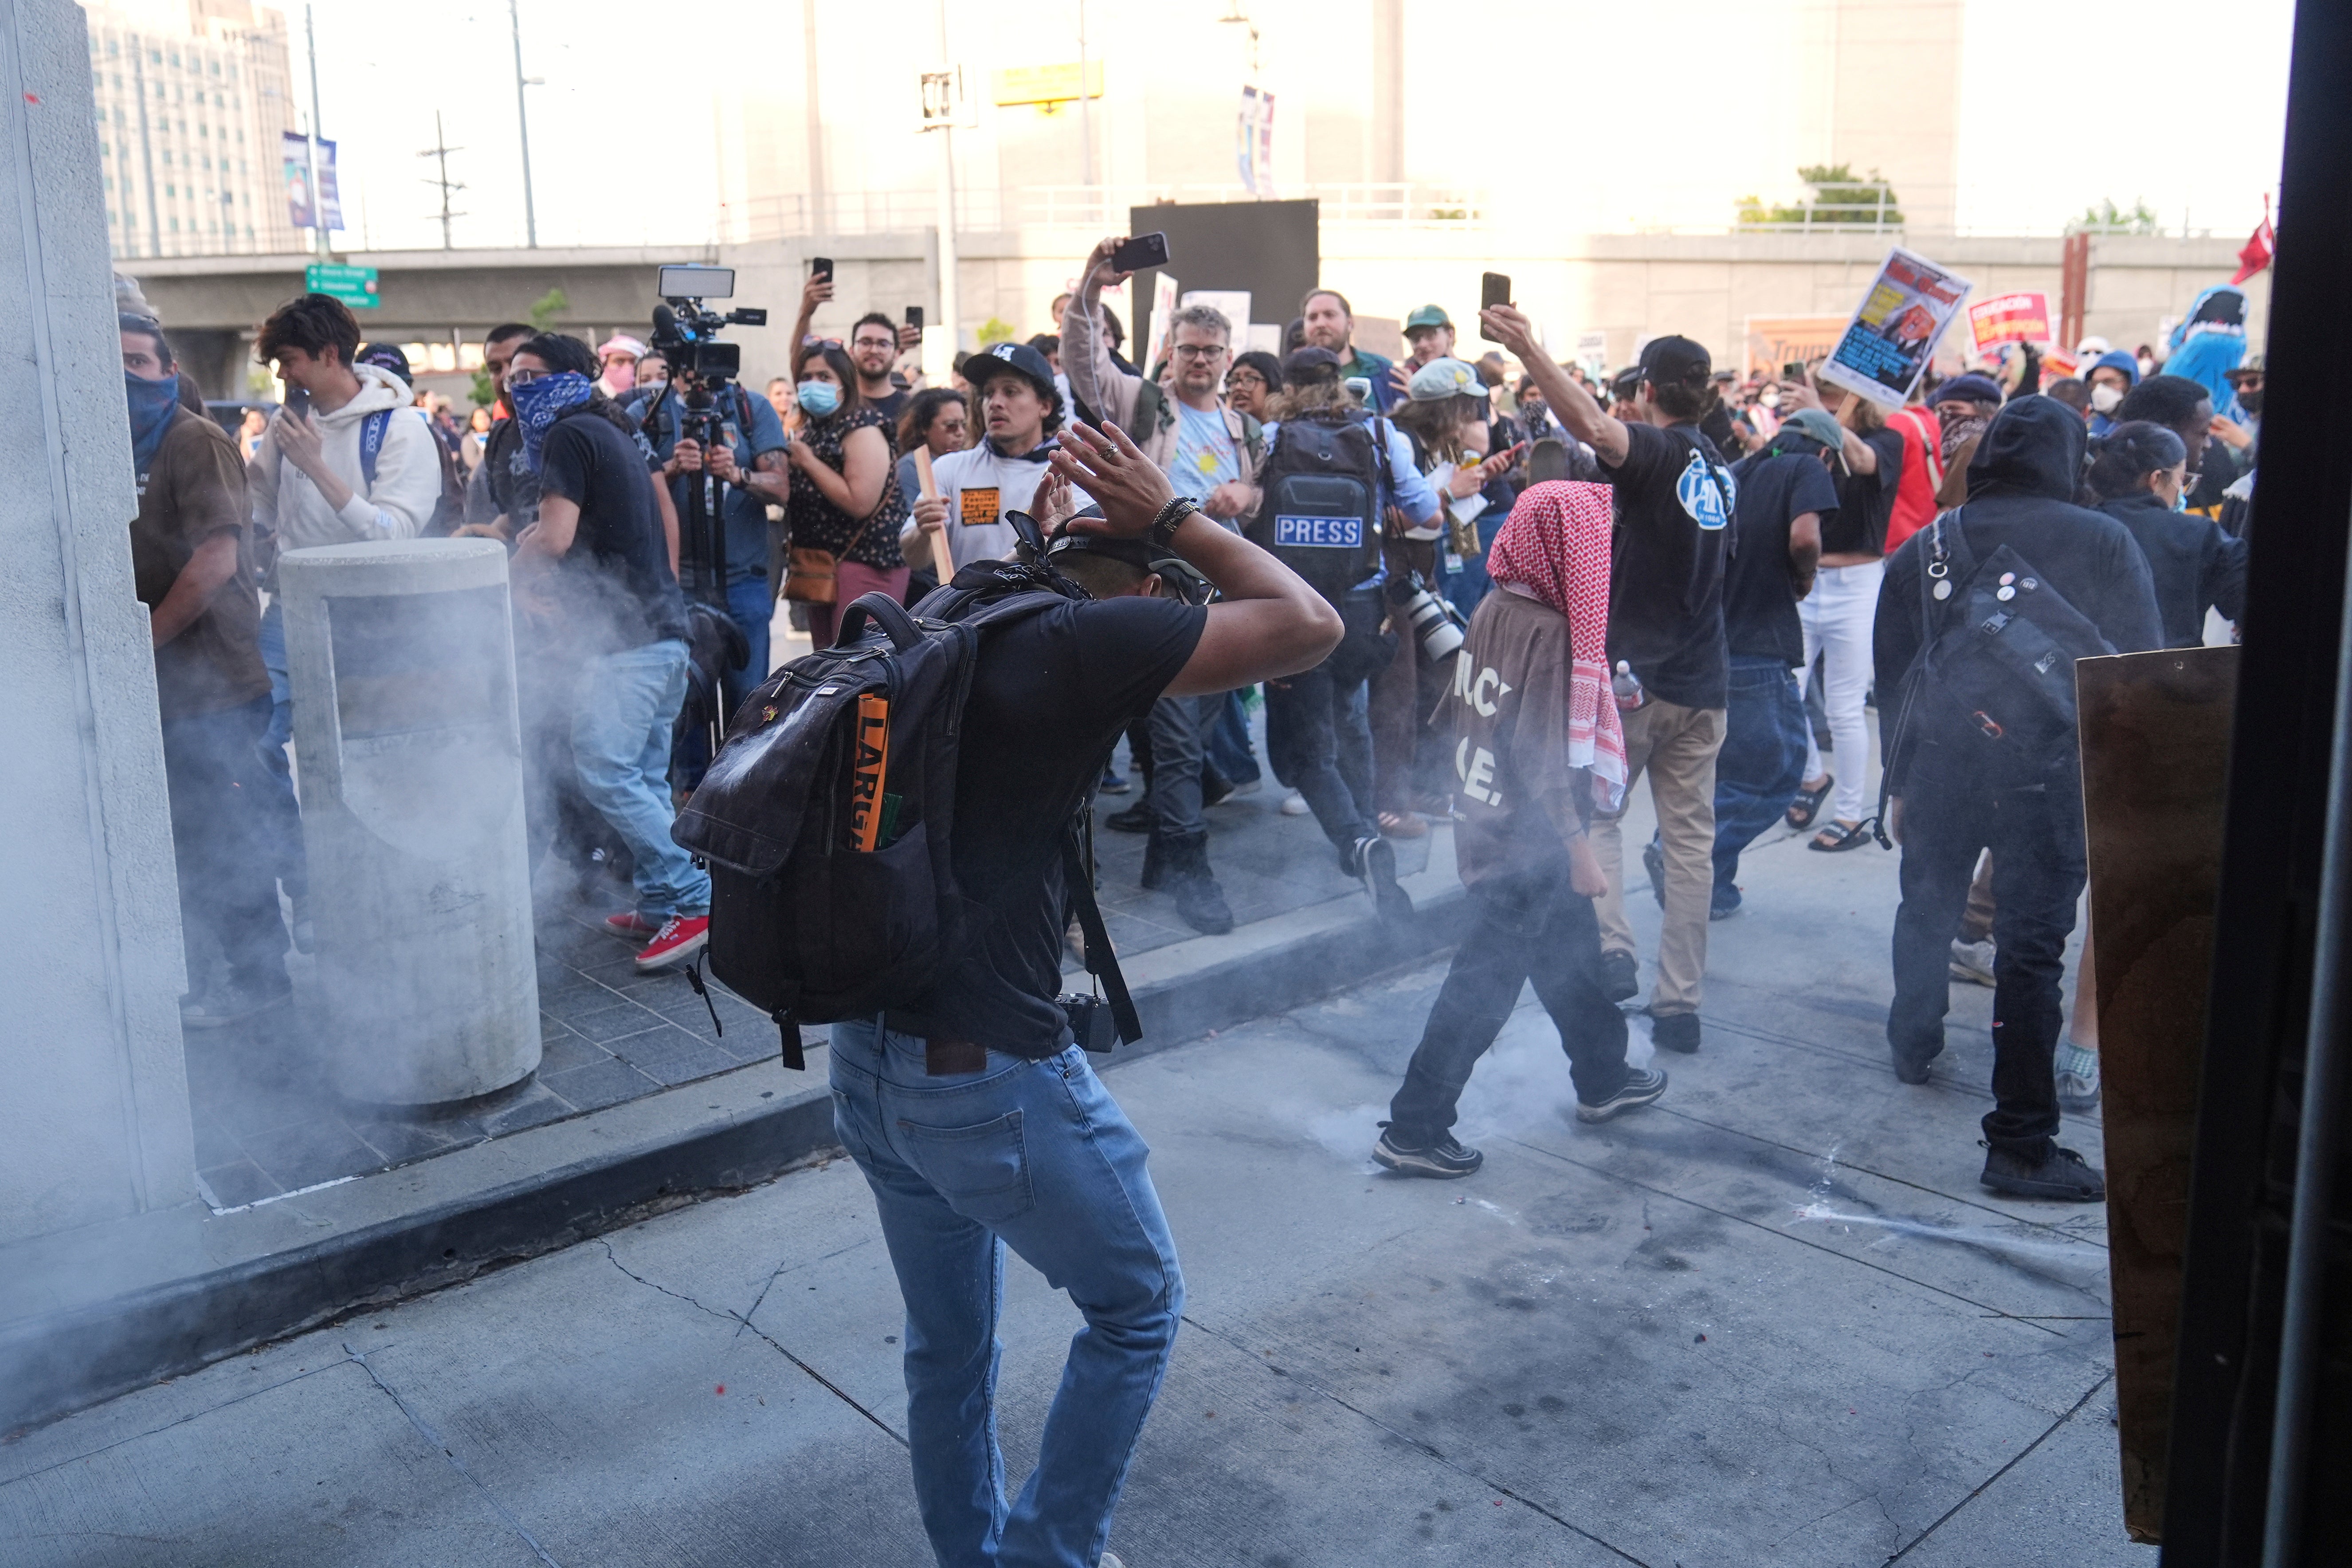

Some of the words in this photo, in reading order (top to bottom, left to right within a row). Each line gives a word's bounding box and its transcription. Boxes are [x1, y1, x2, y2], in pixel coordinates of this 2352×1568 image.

[992, 343, 1015, 361] LA
[1773, 339, 1833, 361] Trum
[1280, 519, 1358, 544] PRESS
